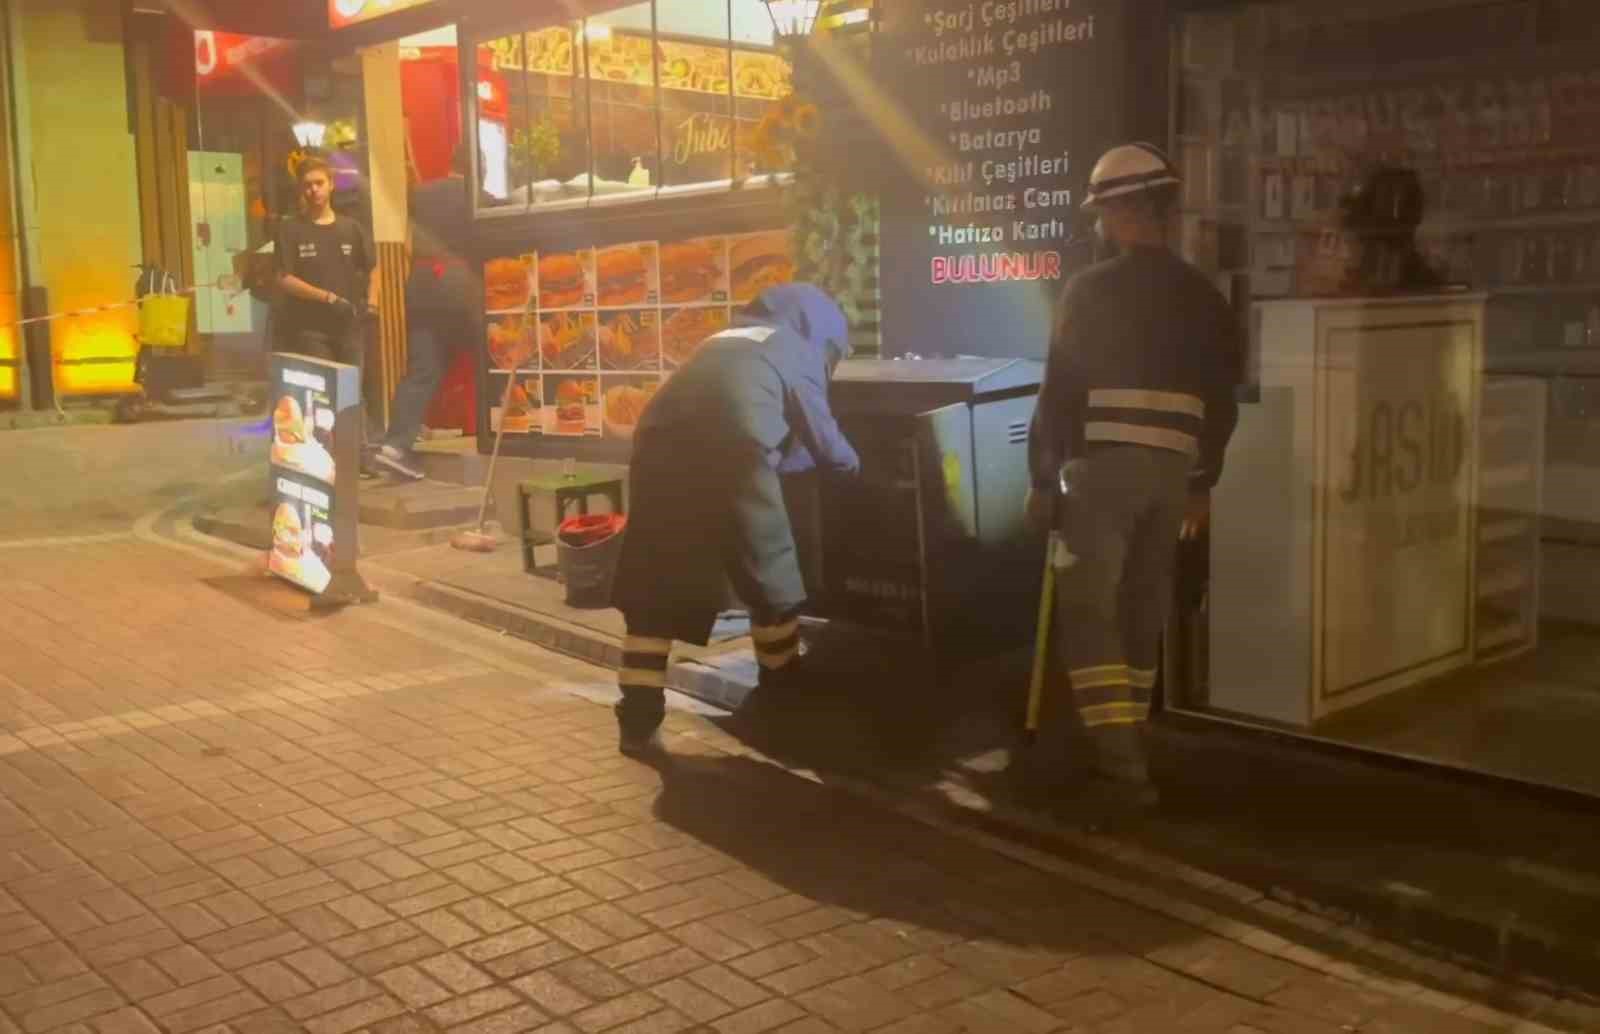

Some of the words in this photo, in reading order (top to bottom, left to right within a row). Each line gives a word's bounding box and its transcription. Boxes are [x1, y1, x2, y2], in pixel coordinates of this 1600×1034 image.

[1002, 16, 1095, 56] Çeşitleri
[976, 61, 1021, 90] Mp3
[950, 91, 1051, 121] Bluetooth
[959, 128, 1041, 151] Batarya
[981, 152, 1069, 184] Çeşitleri
[1023, 188, 1071, 208] Cam
[939, 223, 1003, 244] Hafıza
[1012, 219, 1064, 240] Kartı
[931, 251, 1061, 284] BULUNUR
